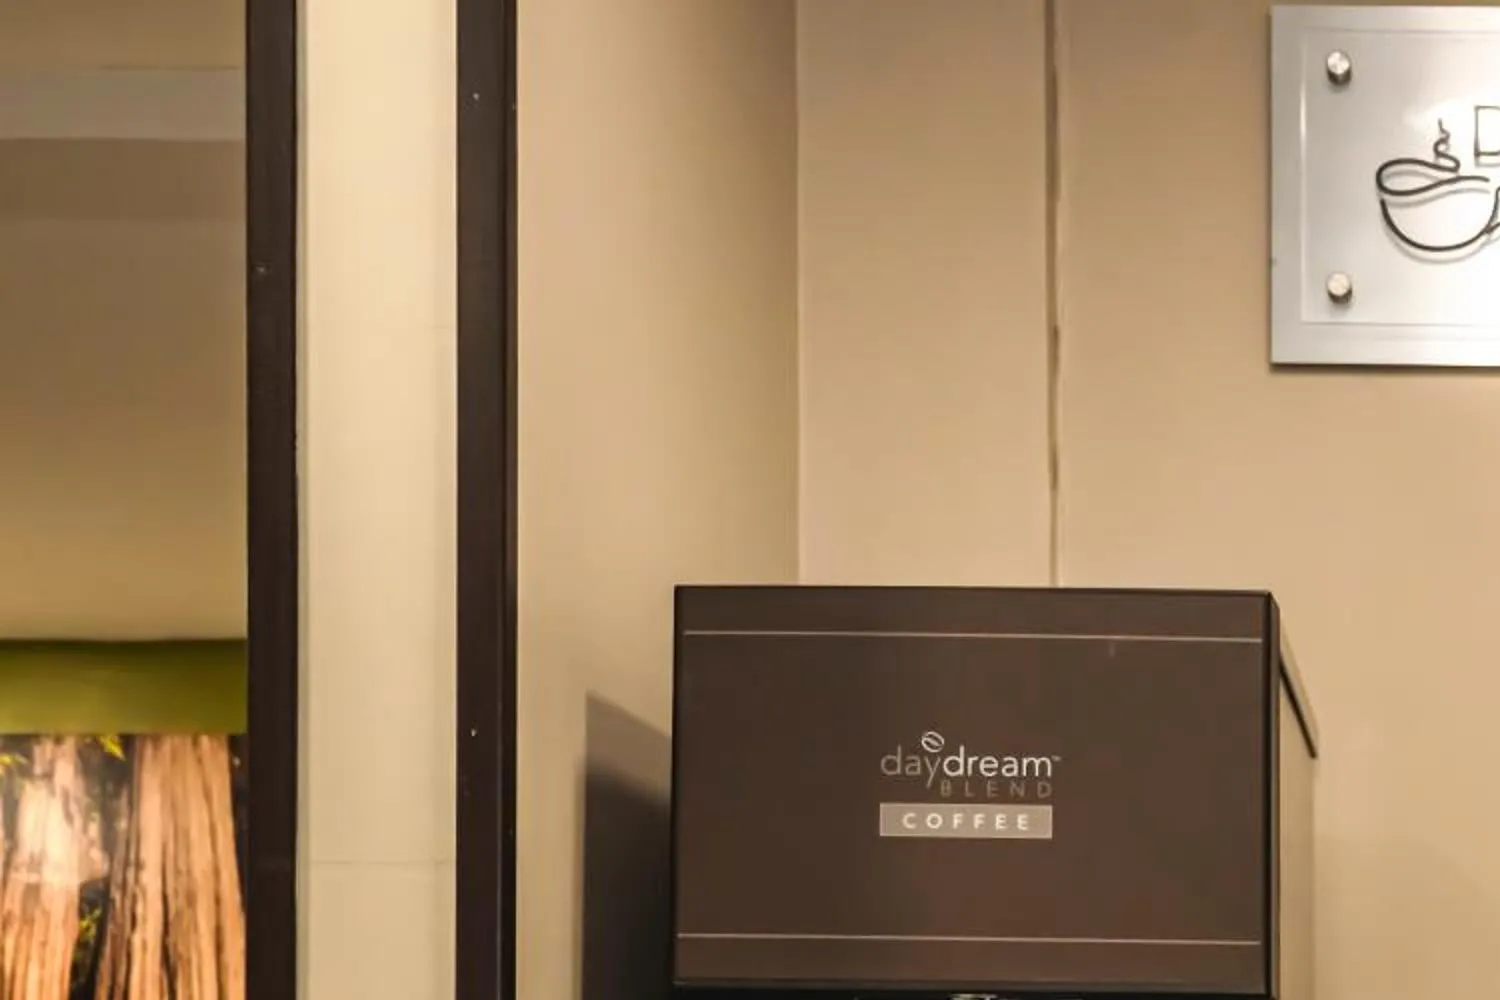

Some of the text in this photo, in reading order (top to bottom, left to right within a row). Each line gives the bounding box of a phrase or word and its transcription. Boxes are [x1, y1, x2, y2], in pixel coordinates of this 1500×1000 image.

[880, 744, 1053, 789] daydream
[940, 779, 1053, 798] BLEND
[902, 812, 1029, 831] COFFEE
